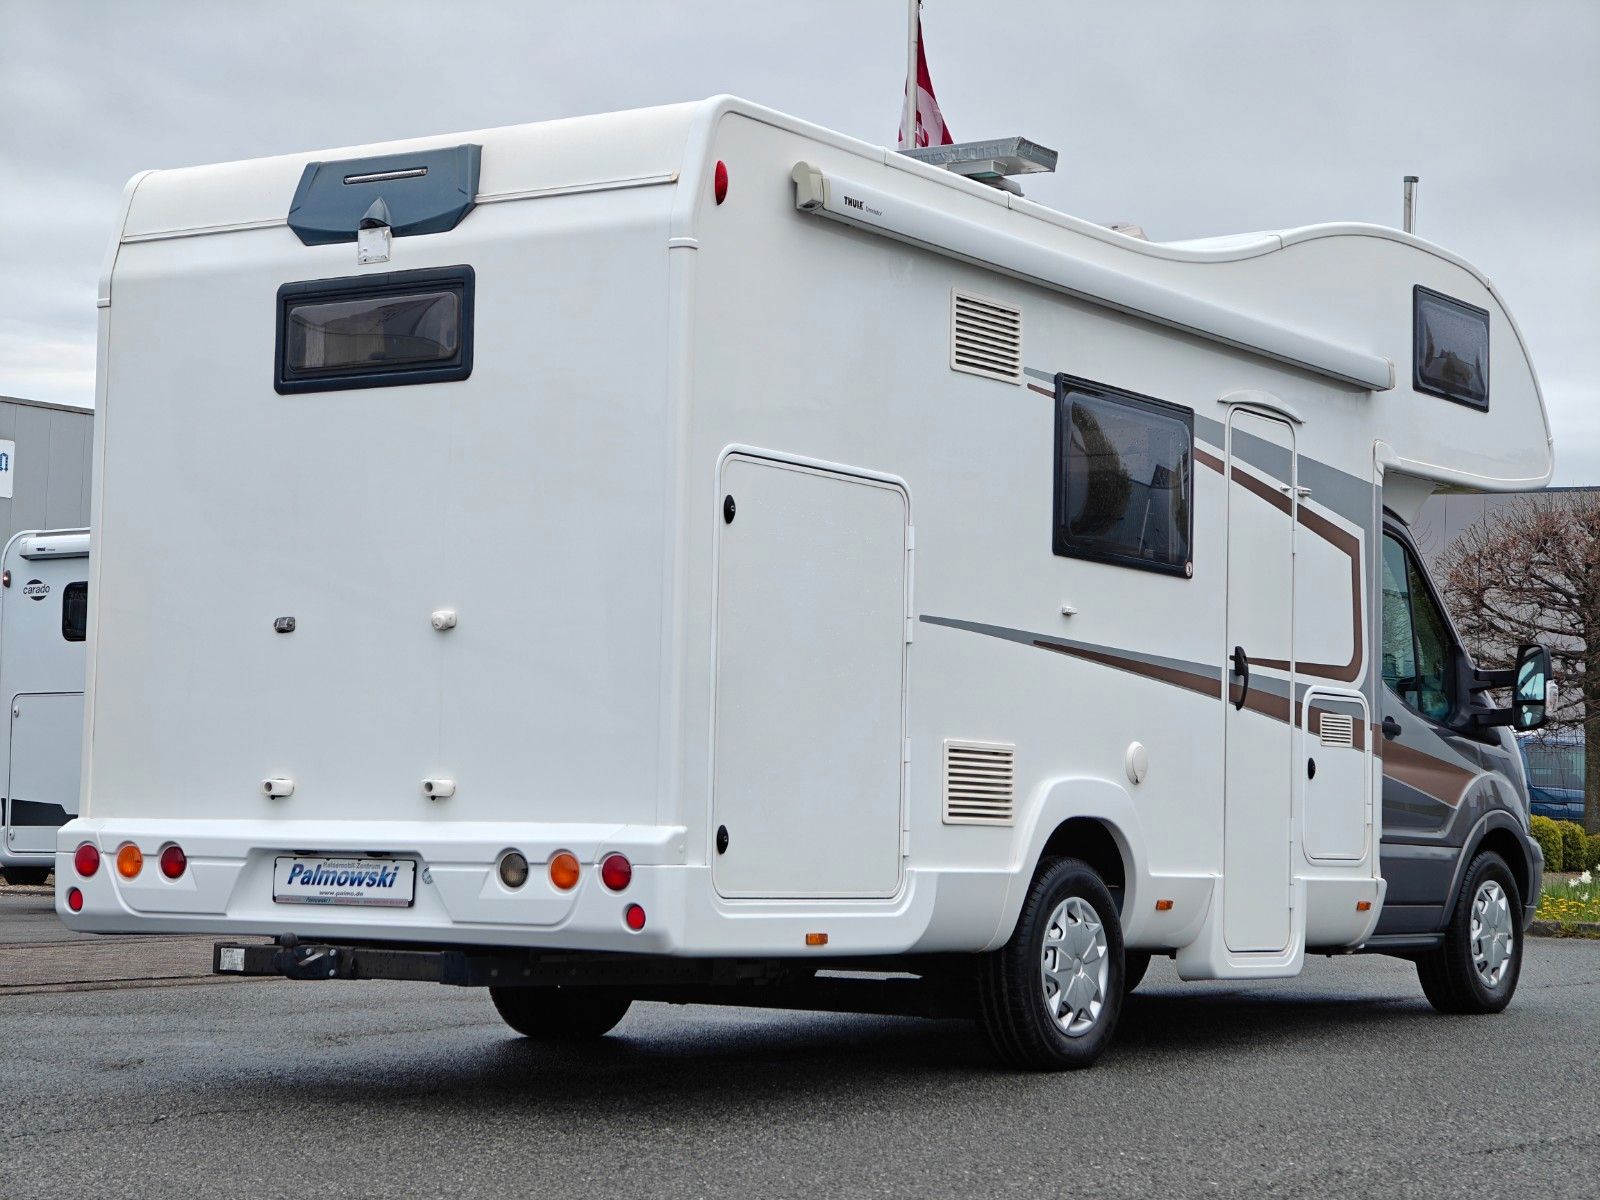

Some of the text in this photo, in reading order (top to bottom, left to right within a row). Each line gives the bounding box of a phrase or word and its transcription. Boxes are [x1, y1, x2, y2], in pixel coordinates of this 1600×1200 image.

[843, 195, 864, 210] THULE
[23, 584, 50, 594] carado
[287, 863, 400, 888] Palmowski
